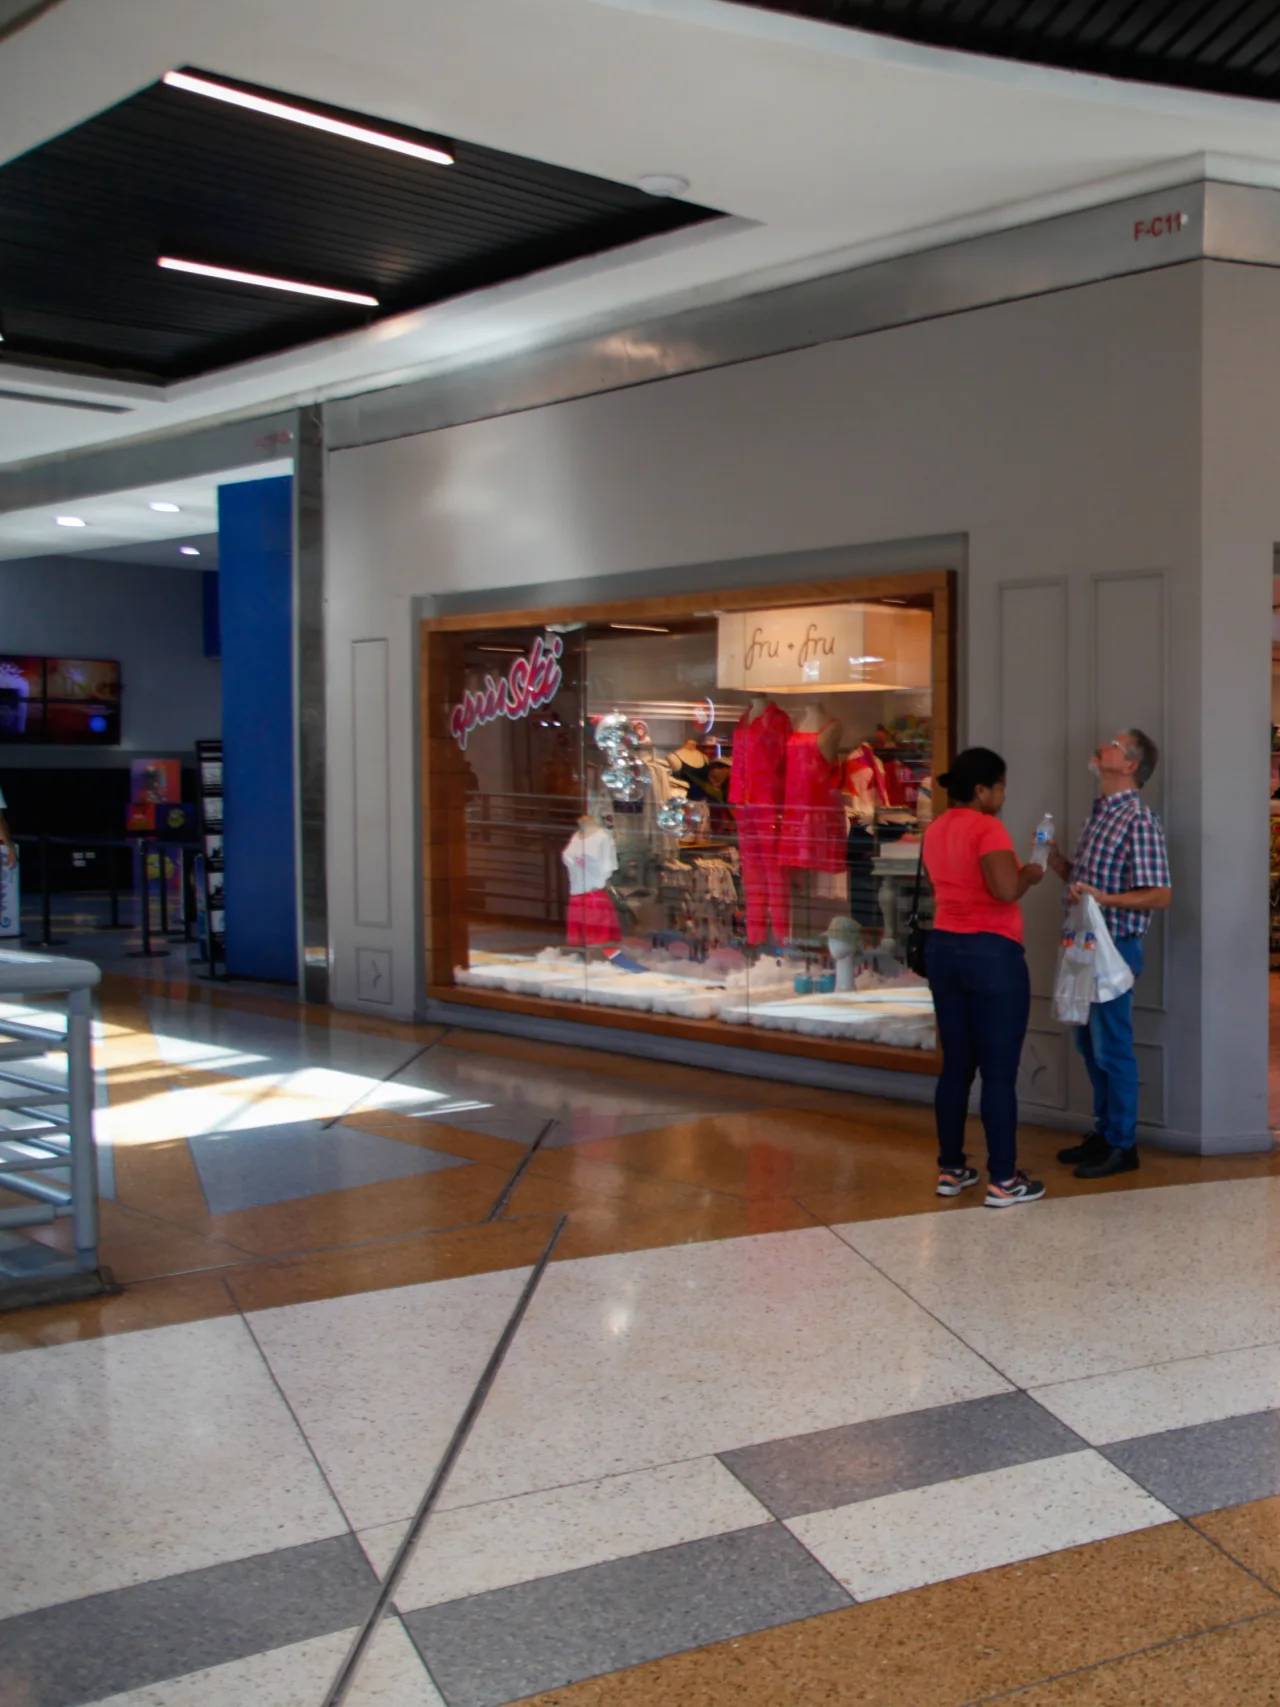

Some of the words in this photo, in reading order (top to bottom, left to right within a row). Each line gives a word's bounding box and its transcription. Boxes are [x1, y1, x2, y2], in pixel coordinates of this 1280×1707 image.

[1133, 211, 1182, 242] F-C11
[744, 627, 780, 671] fru
[797, 623, 836, 668] fru
